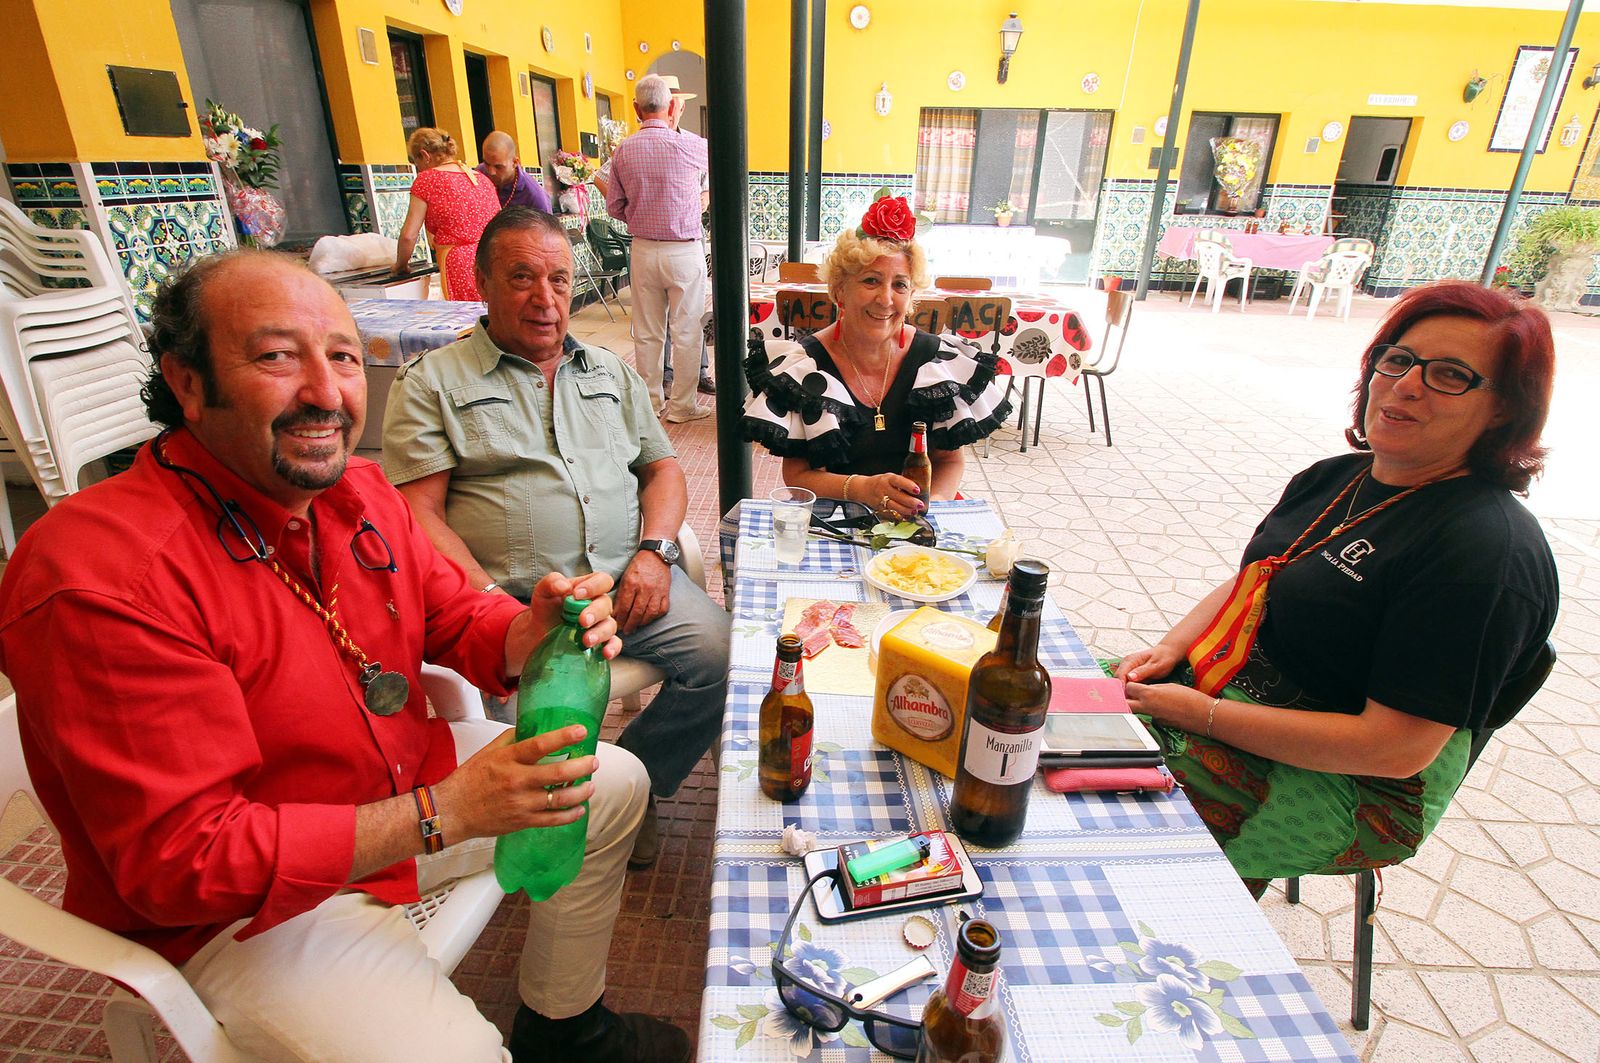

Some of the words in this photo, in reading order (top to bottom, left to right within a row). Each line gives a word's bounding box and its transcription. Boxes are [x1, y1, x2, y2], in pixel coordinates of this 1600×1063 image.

[1337, 563, 1363, 582] PIEDAD
[890, 695, 949, 721] Alhambra
[986, 735, 1032, 753] Manzanilla
